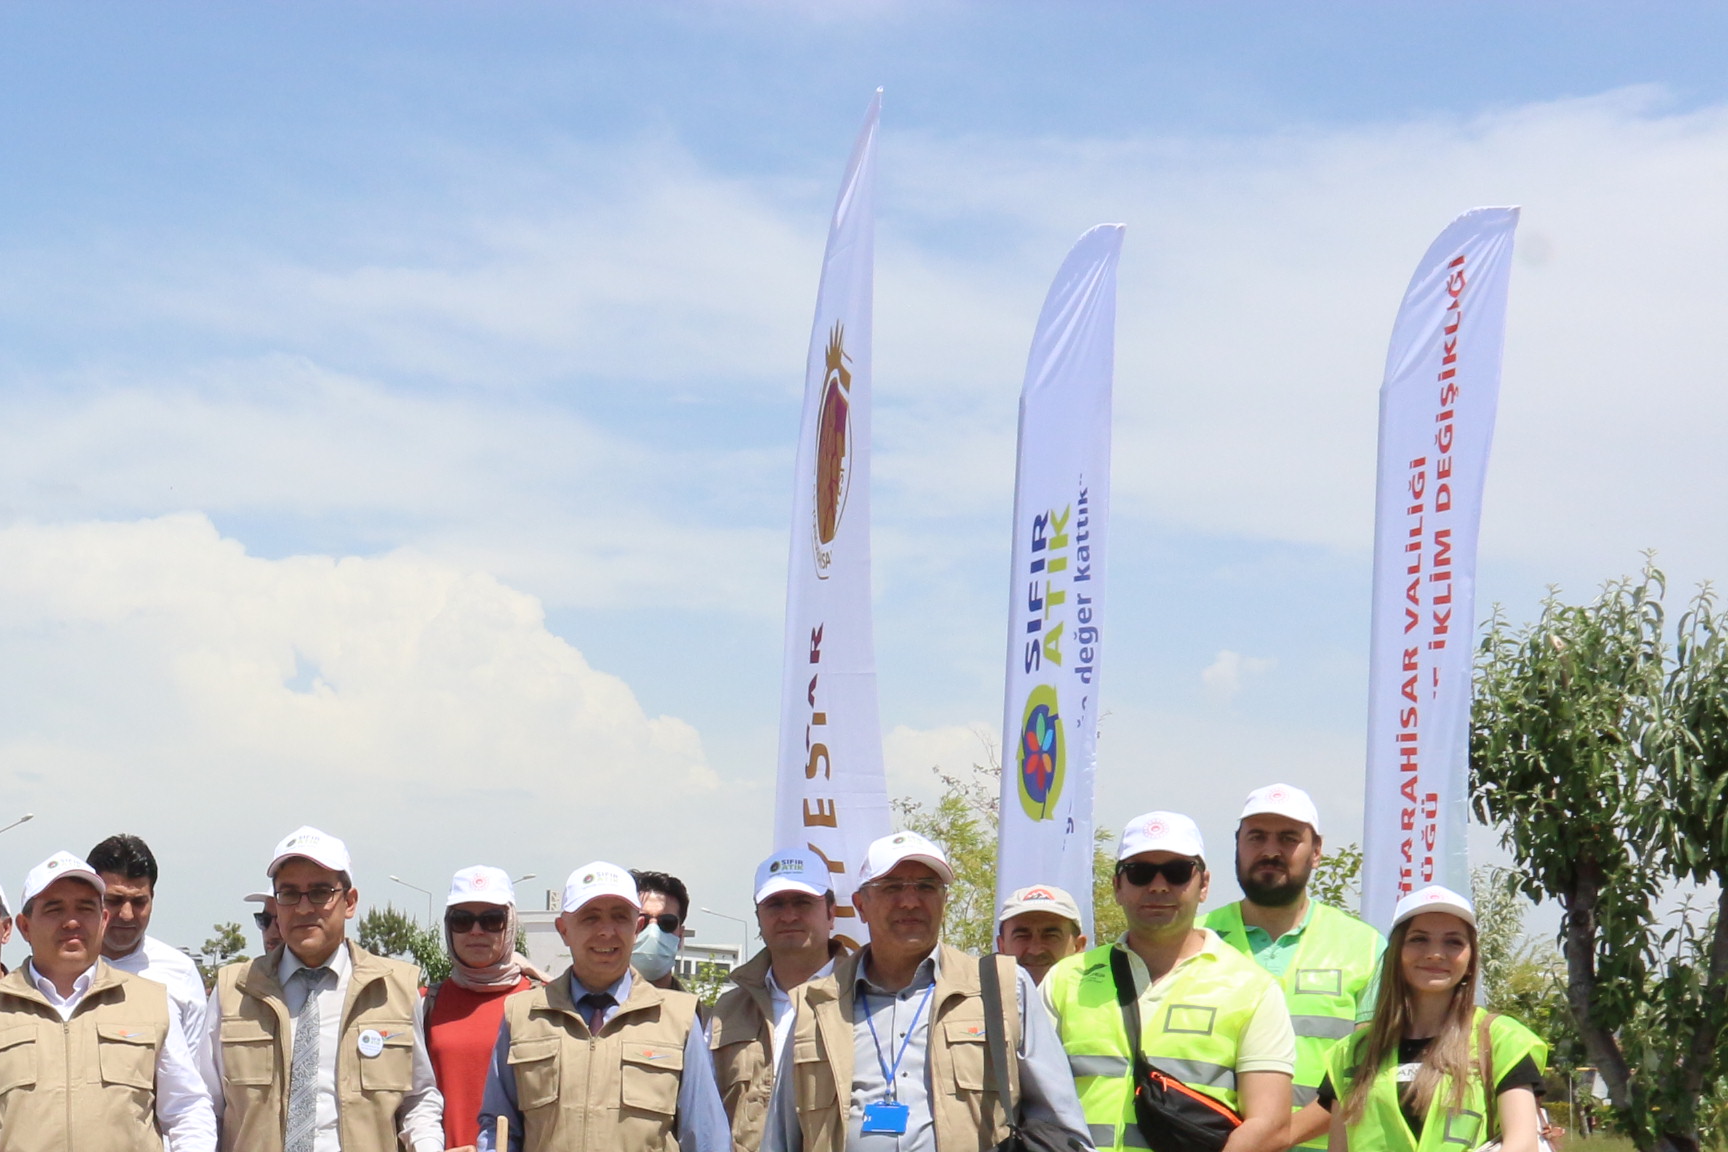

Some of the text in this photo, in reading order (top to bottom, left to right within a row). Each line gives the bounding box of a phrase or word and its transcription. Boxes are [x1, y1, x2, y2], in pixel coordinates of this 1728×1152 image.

[1024, 508, 1050, 675] SIFIR
[1042, 502, 1072, 668] ATIK
[1404, 456, 1426, 634] VALİLİĞİ
[1428, 529, 1453, 650] İKLİM
